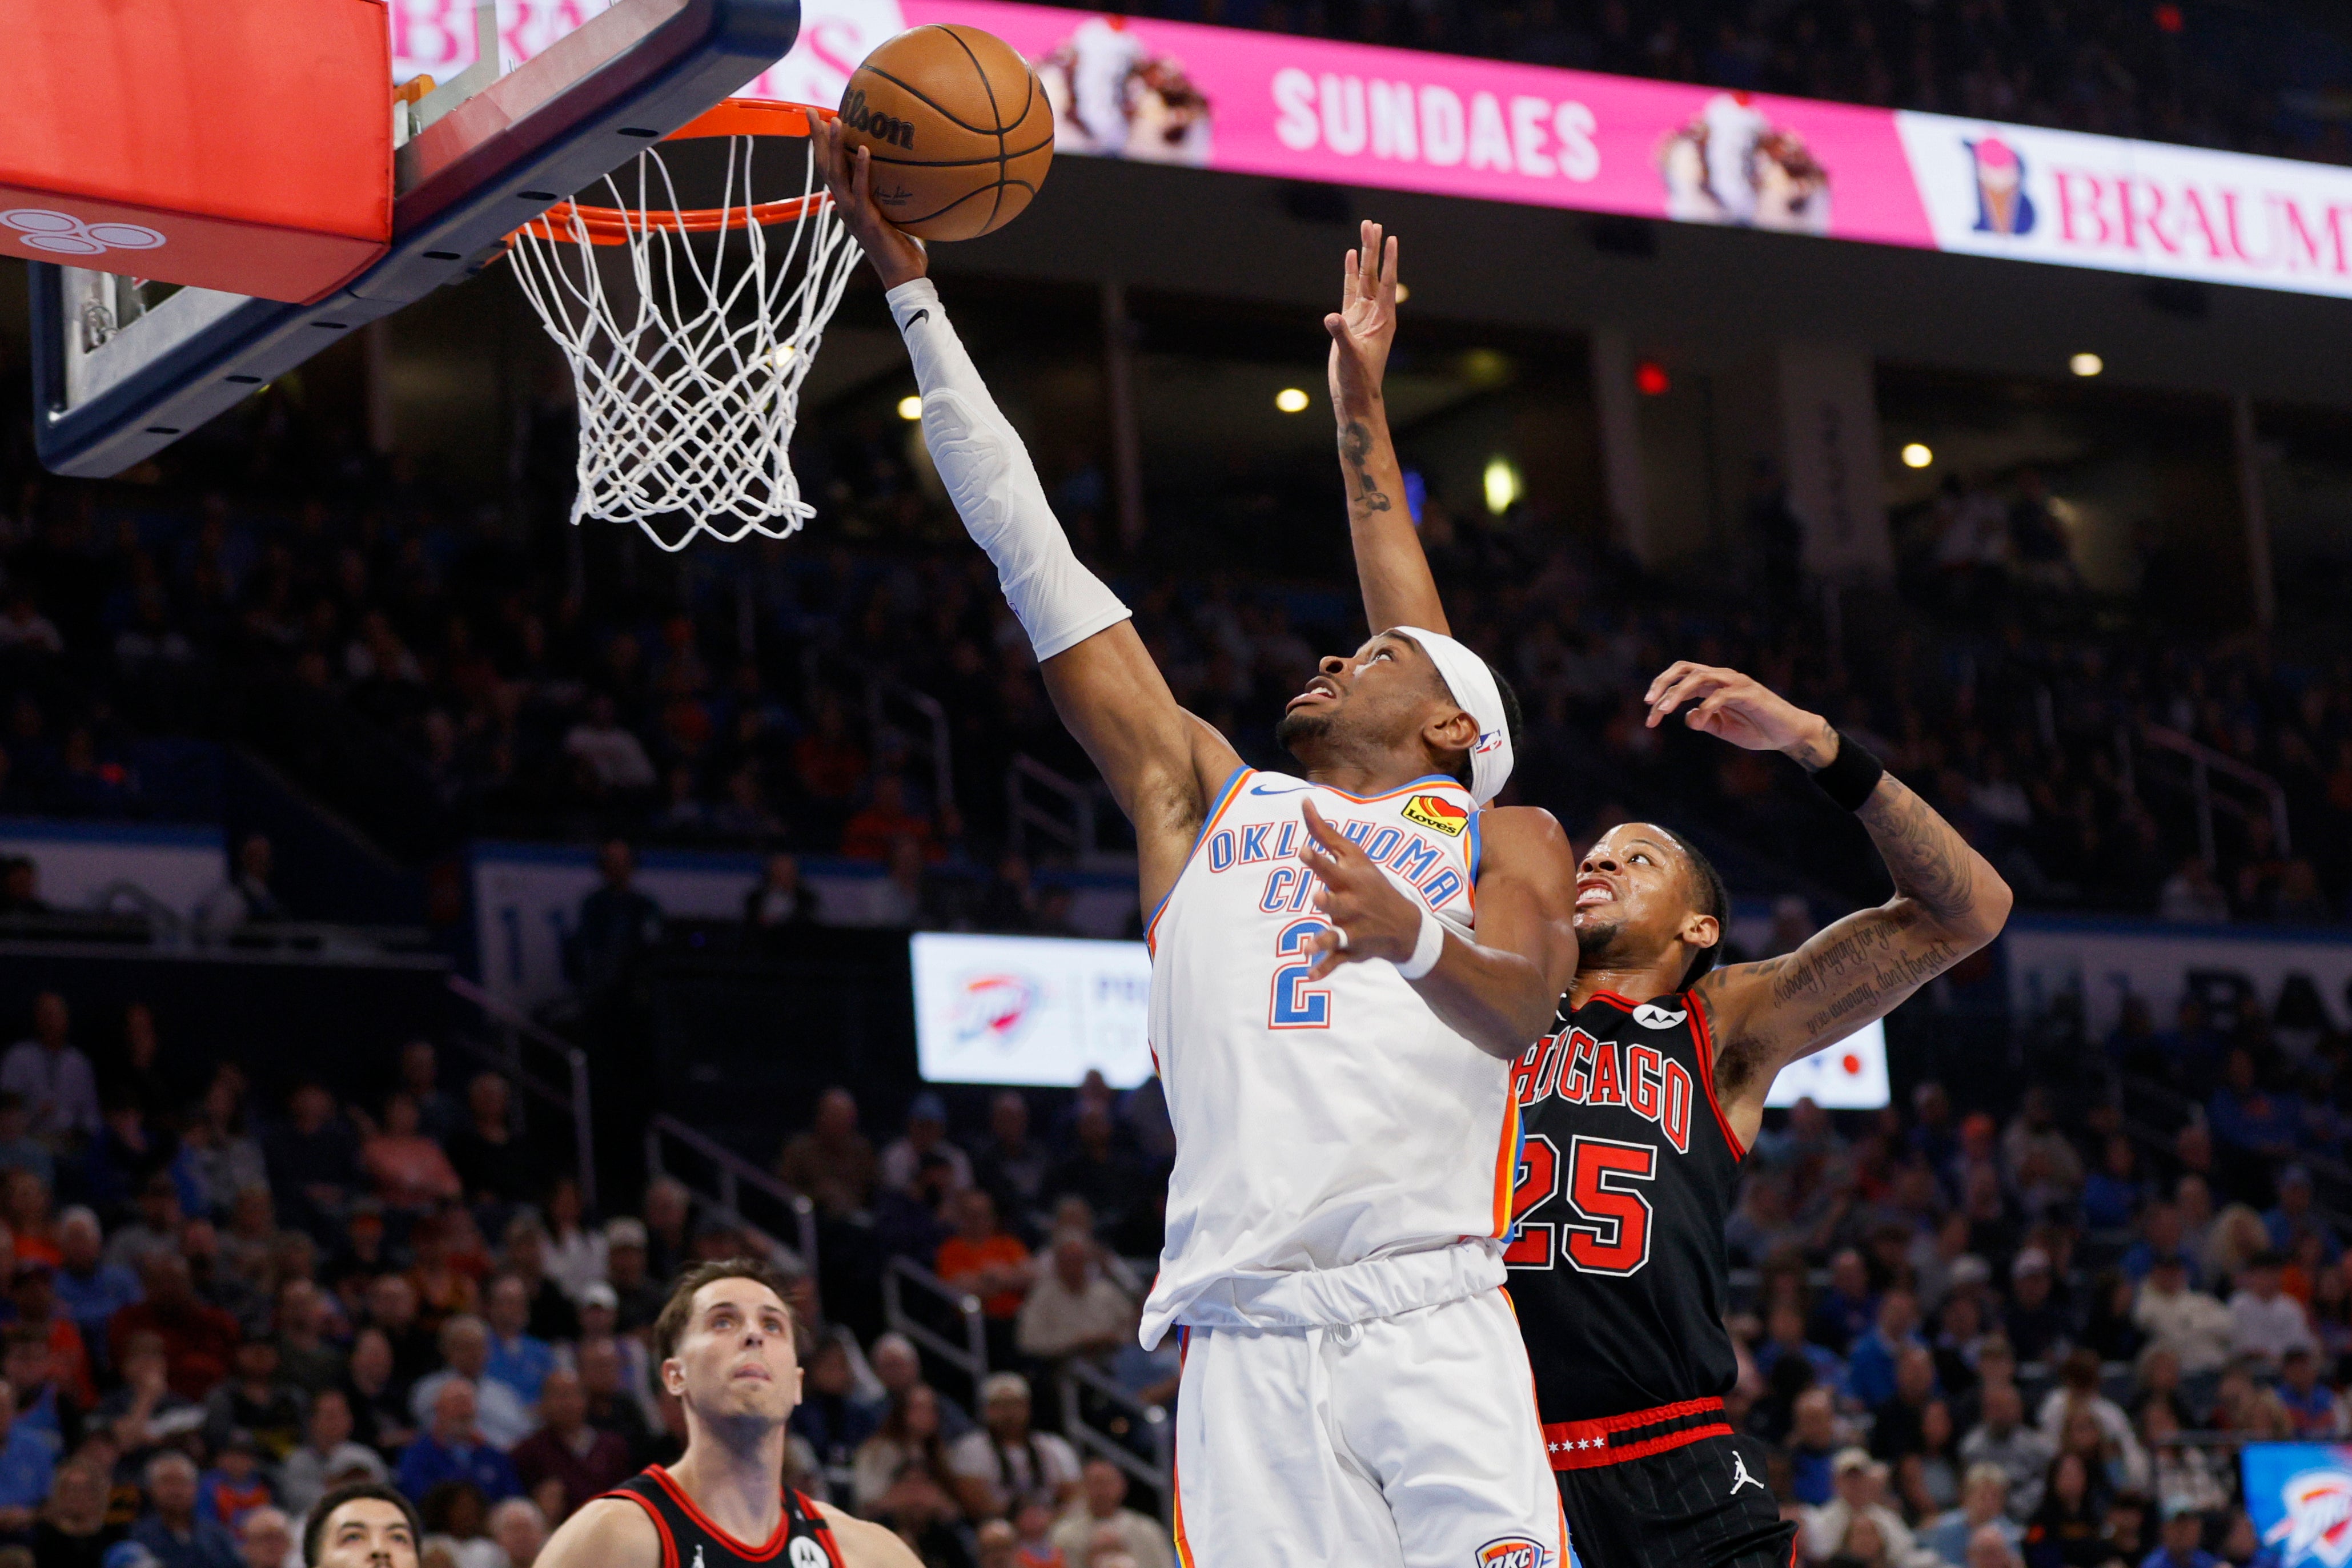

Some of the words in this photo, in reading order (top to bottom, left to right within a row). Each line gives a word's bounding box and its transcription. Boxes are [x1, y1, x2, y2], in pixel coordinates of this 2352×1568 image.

[840, 89, 915, 150] ilson
[1273, 67, 1600, 183] SUNDAES
[1259, 866, 1332, 914] CI
[1269, 916, 1331, 1030] 2
[1852, 920, 1874, 961] for
[1900, 943, 1947, 982] forget
[1511, 1025, 1693, 1155] HICAGO
[1503, 1134, 1657, 1277] 25
